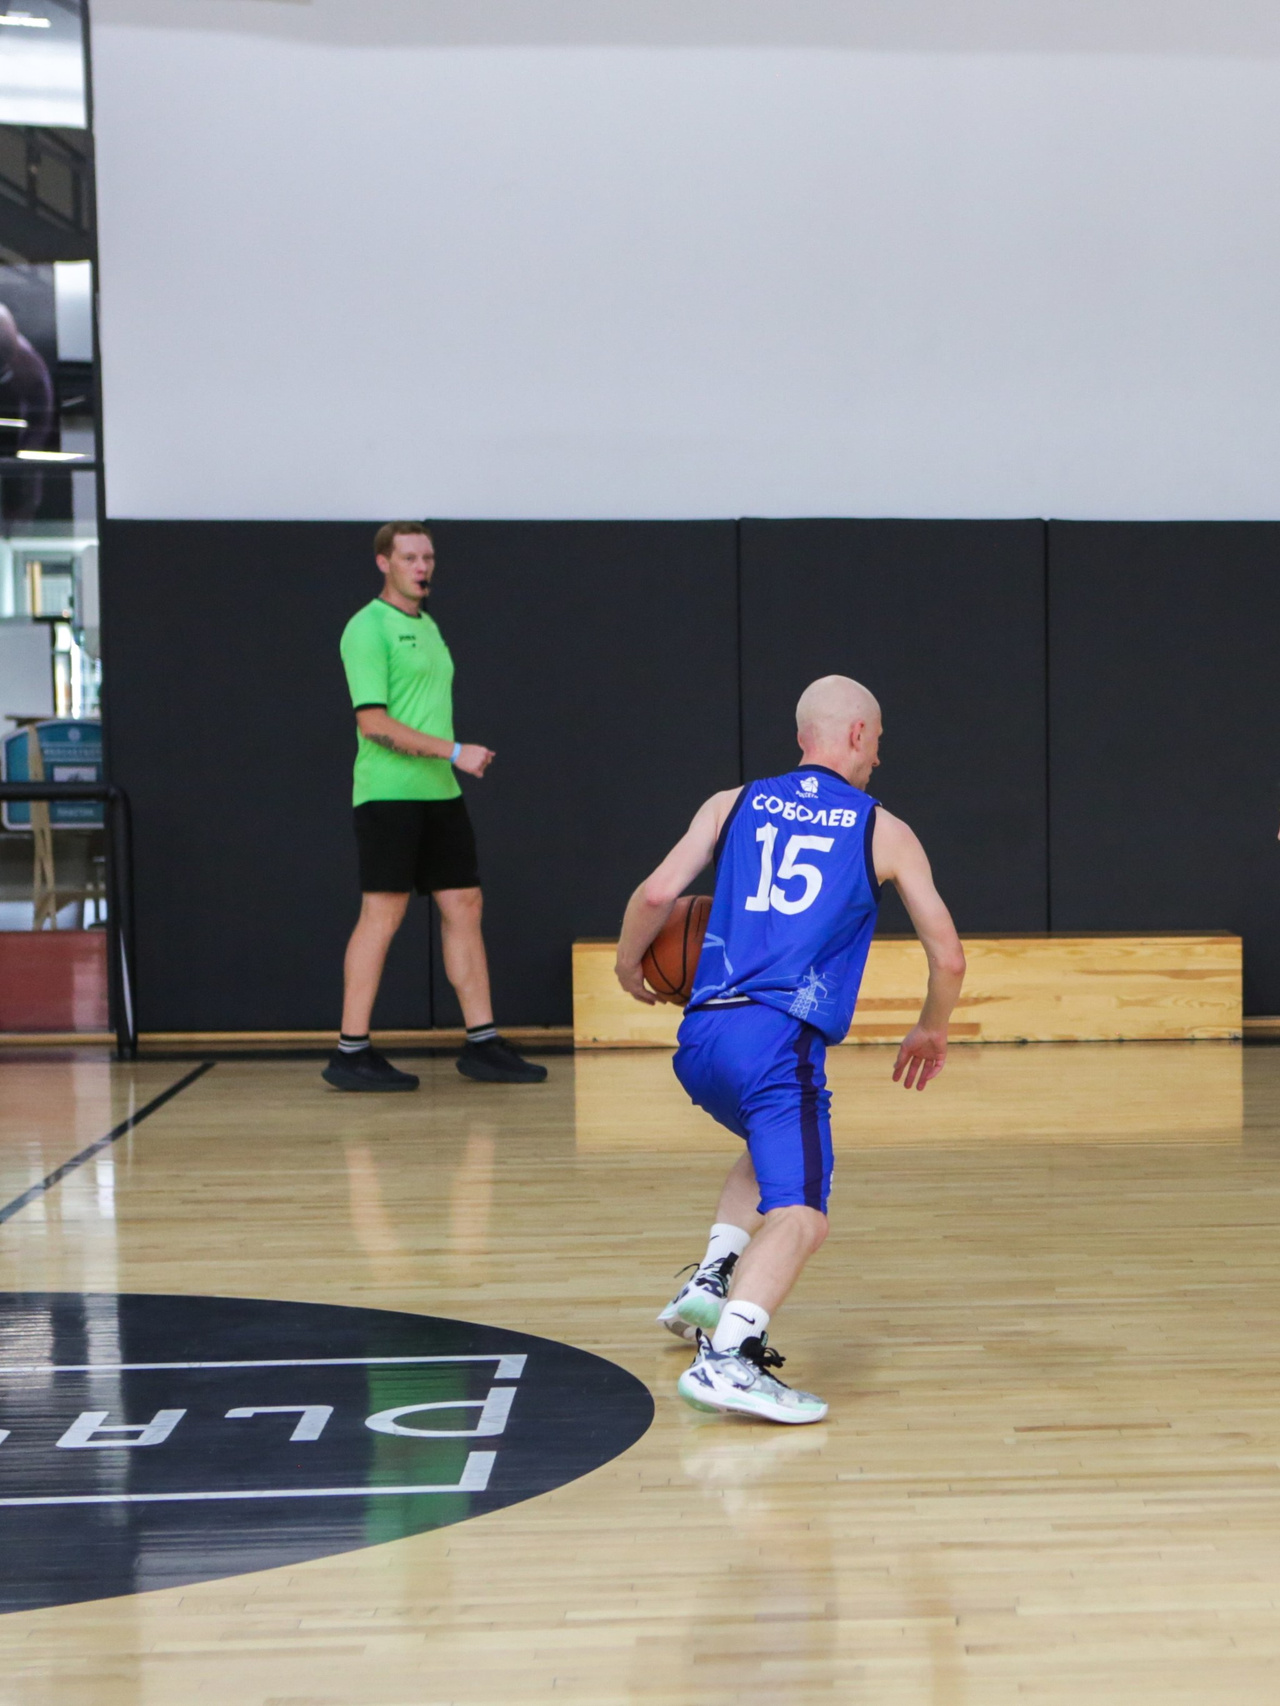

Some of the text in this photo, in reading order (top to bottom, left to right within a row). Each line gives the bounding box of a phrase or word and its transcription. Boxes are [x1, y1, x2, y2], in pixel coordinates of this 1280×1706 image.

[752, 793, 857, 827] СОБОЛЕВ
[744, 822, 835, 915] 15
[0, 1387, 518, 1449] PLA
